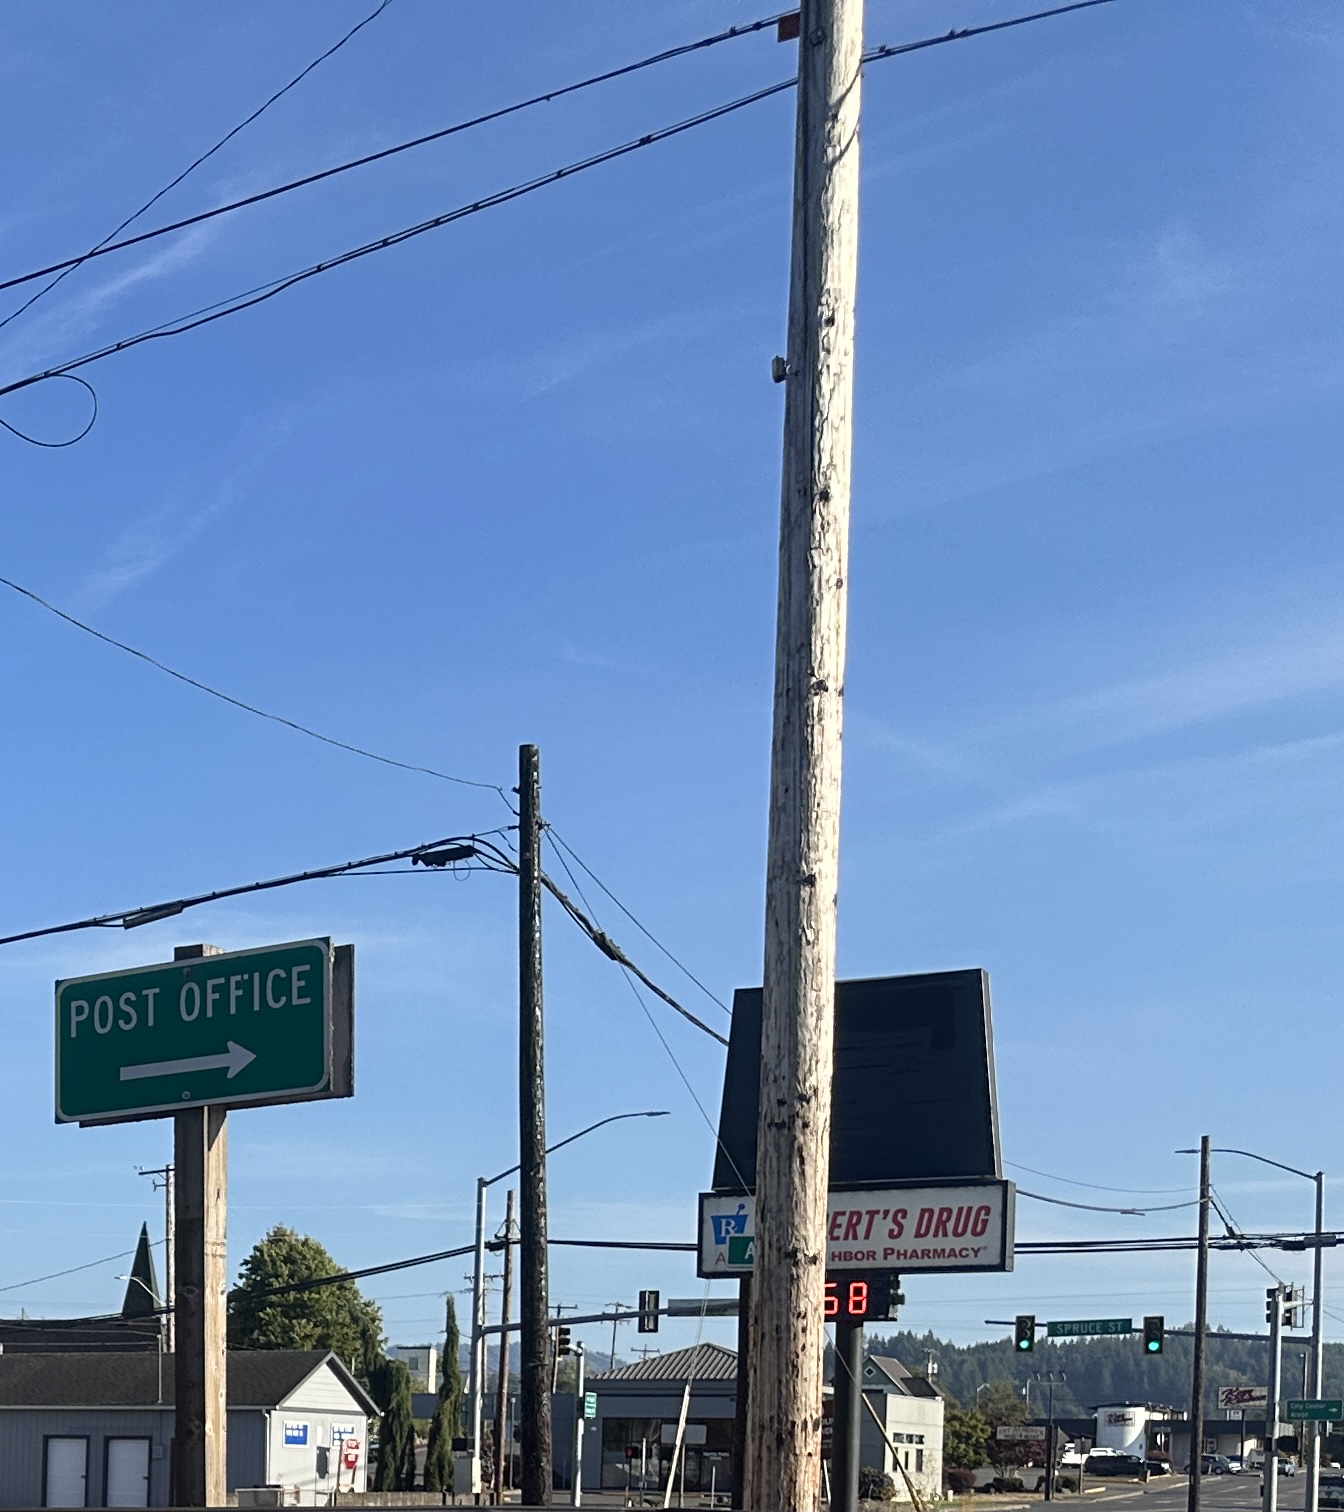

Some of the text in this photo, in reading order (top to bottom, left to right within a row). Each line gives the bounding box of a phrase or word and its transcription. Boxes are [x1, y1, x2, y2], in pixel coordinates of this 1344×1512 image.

[69, 964, 312, 1038] POST OFFICE
[827, 1204, 992, 1242] ERT'S DRUG
[830, 1249, 878, 1262] HBOR
[1056, 1320, 1124, 1335] SPRUCE ST
